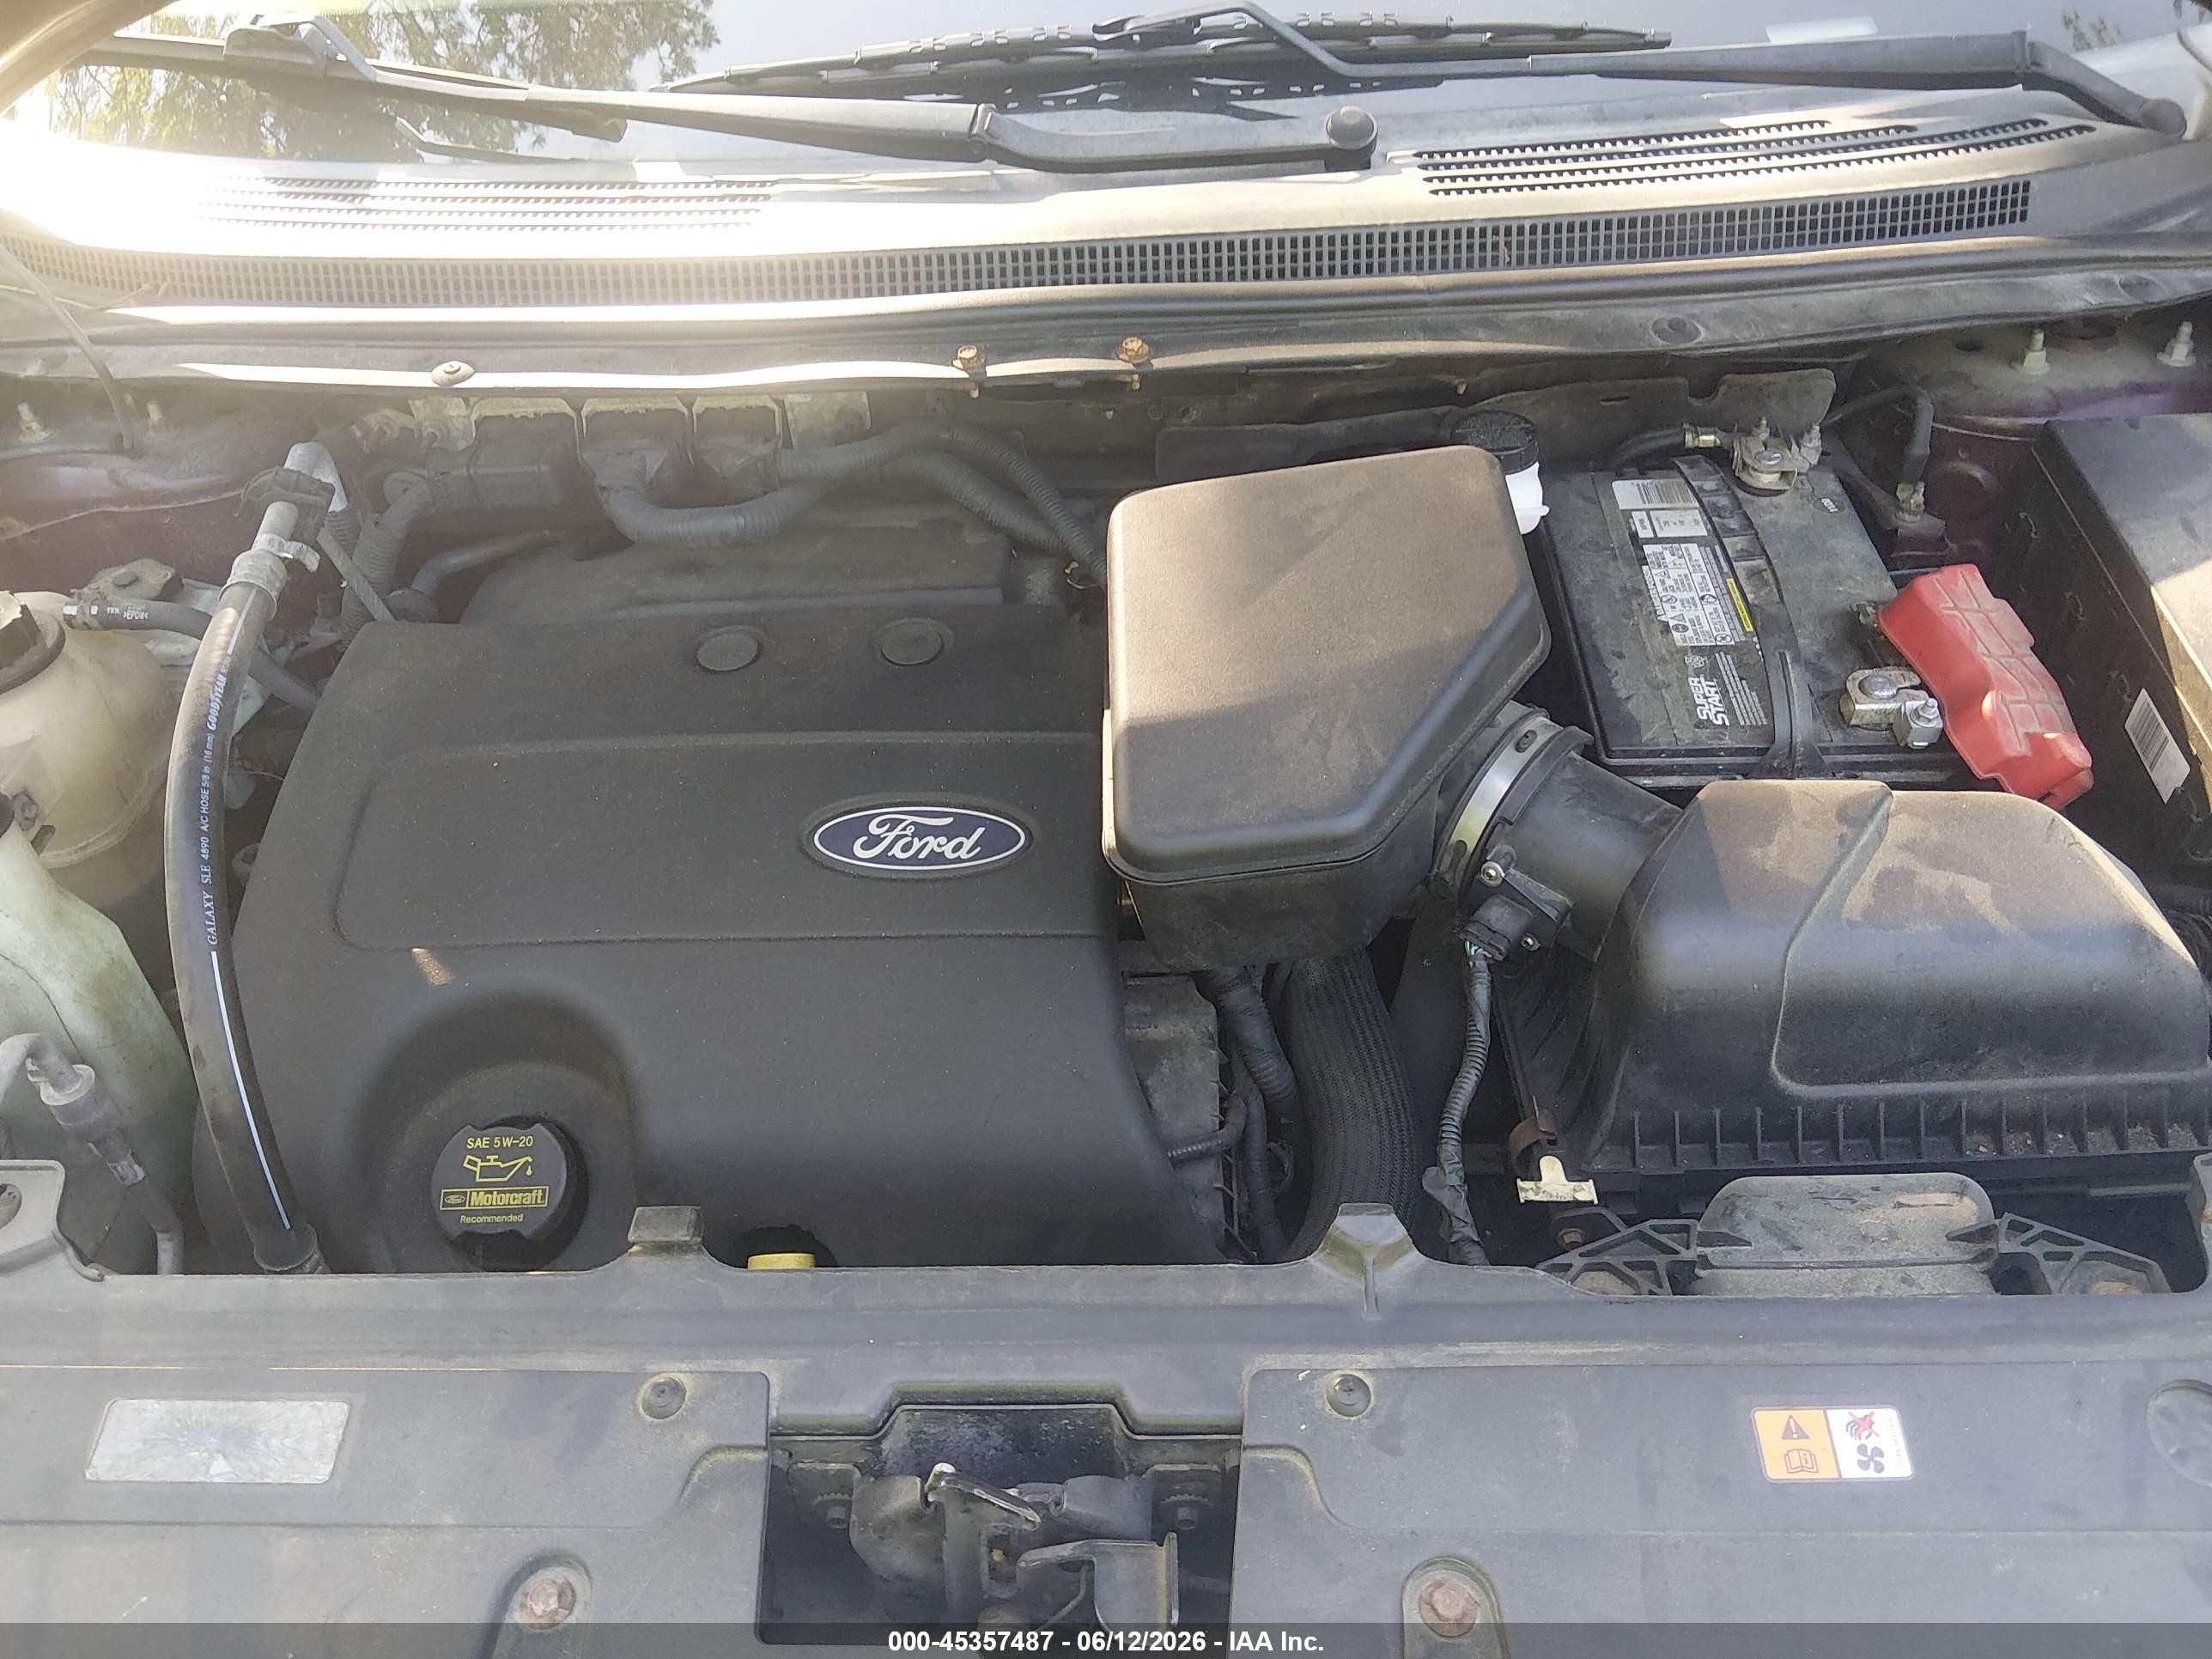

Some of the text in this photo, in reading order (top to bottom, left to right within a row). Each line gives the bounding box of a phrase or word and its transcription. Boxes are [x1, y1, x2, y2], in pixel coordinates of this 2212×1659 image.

[206, 675, 228, 731] GOODYEAR
[1688, 678, 1709, 720] SUPER
[1702, 675, 1730, 726] START
[199, 787, 210, 813] HOSE
[199, 814, 210, 831] A/C
[853, 813, 986, 860] Ford
[200, 864, 212, 884] SLE
[202, 890, 218, 945] GALAXY
[466, 1134, 533, 1150] SAE 5W-20
[460, 1213, 524, 1224] Recommended
